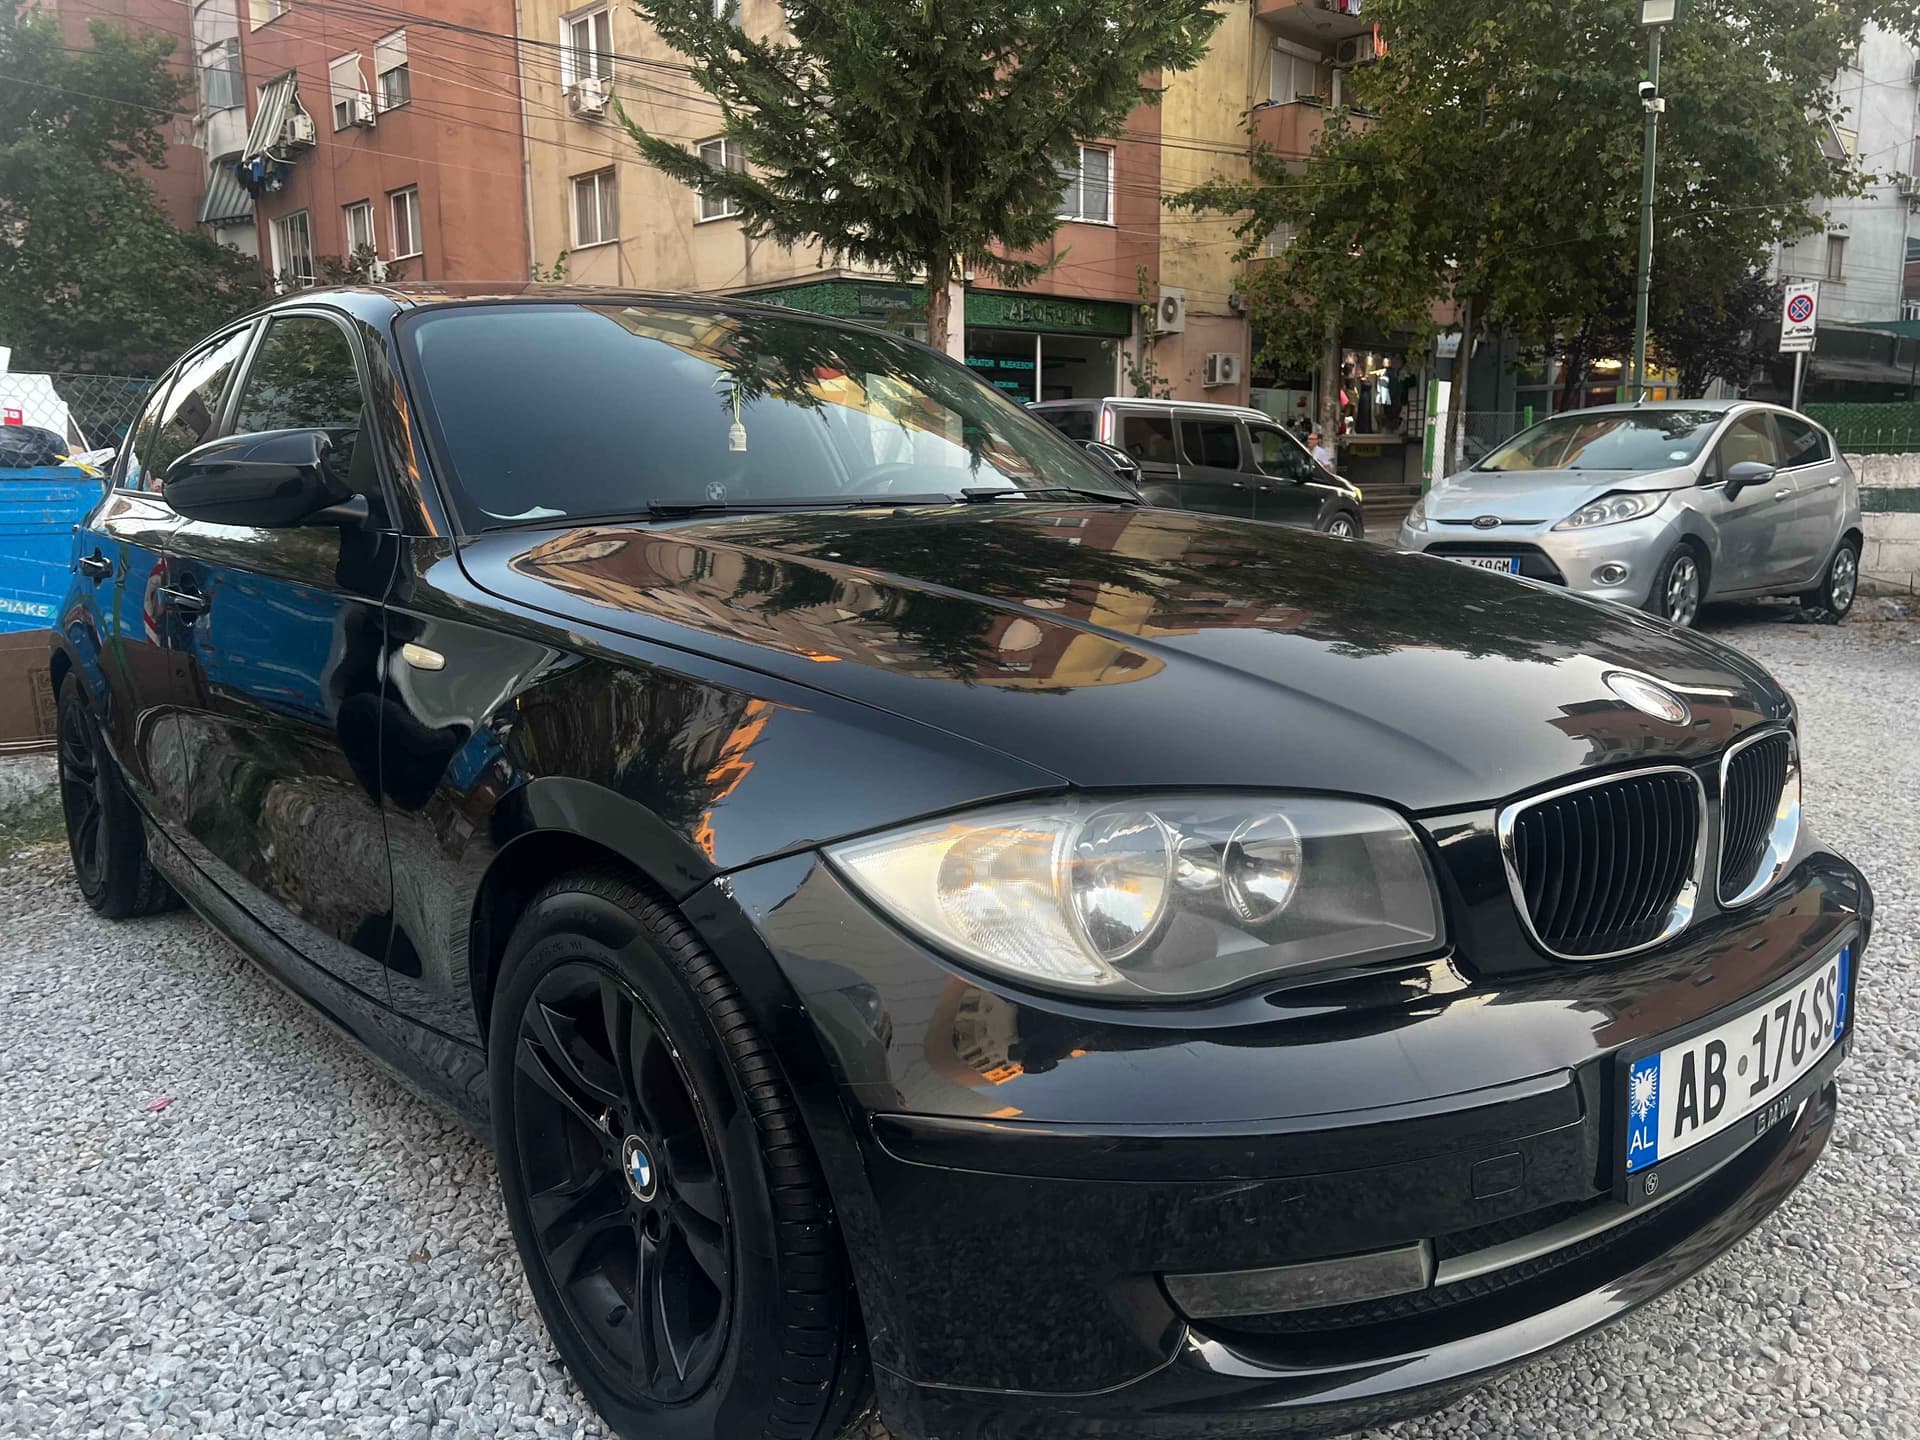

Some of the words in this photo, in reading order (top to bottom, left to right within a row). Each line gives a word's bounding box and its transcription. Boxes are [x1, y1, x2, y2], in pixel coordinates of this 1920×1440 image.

[1674, 1039, 1728, 1138] AB
[1750, 965, 1837, 1097] 176SS
[1629, 1126, 1654, 1155] AL
